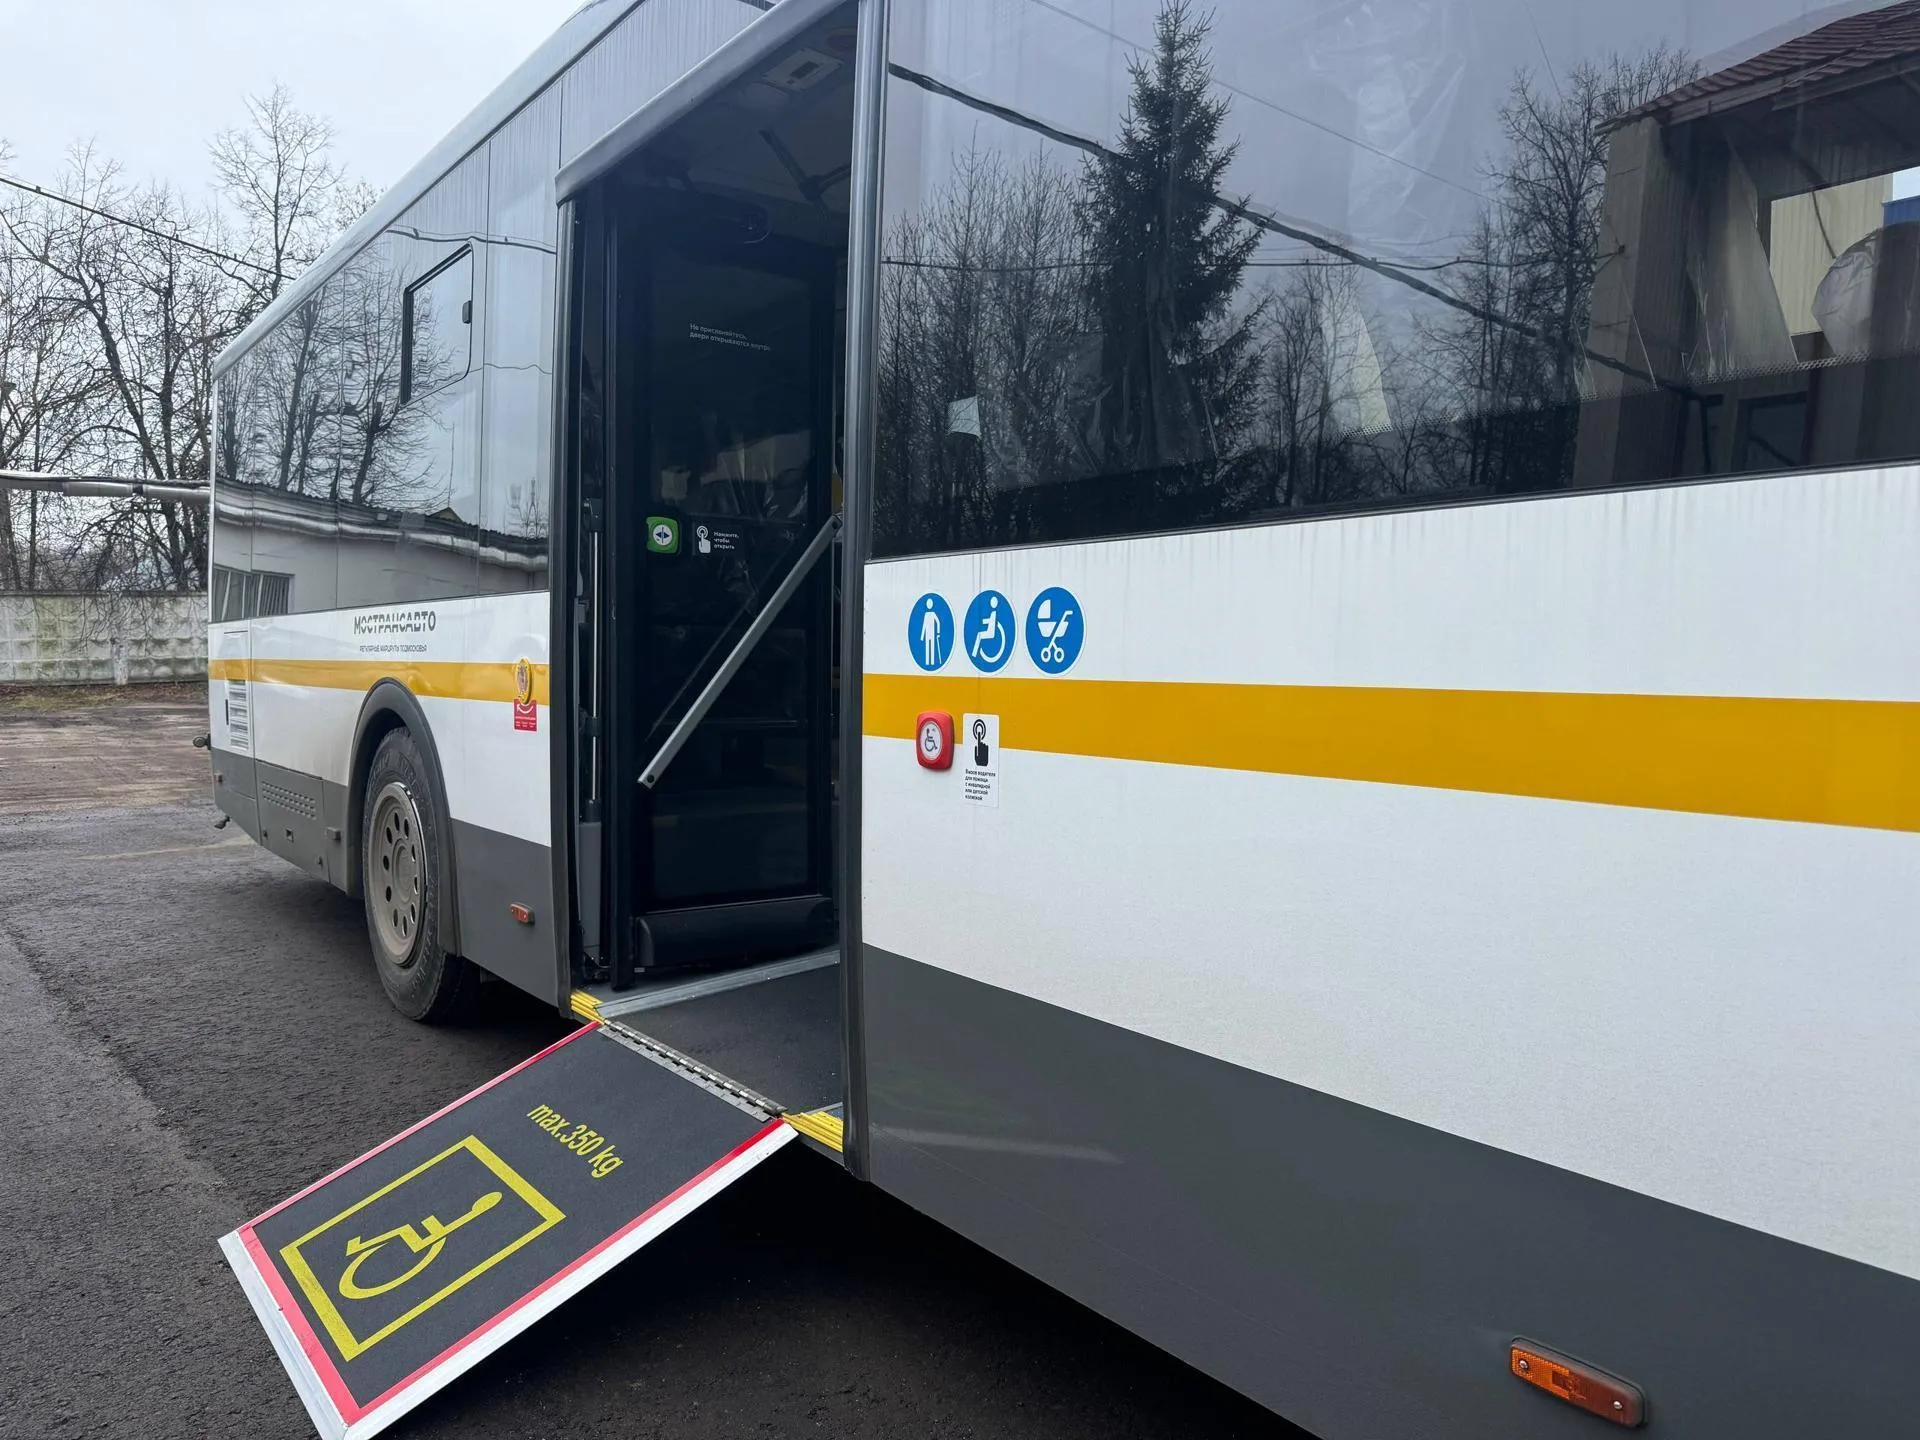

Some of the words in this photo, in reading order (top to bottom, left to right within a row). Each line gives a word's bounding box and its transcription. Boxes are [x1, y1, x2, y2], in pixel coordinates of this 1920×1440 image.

[690, 332, 709, 340] двери
[354, 610, 436, 634] МОСТРАНСАВТО
[588, 1145, 623, 1178] kg
